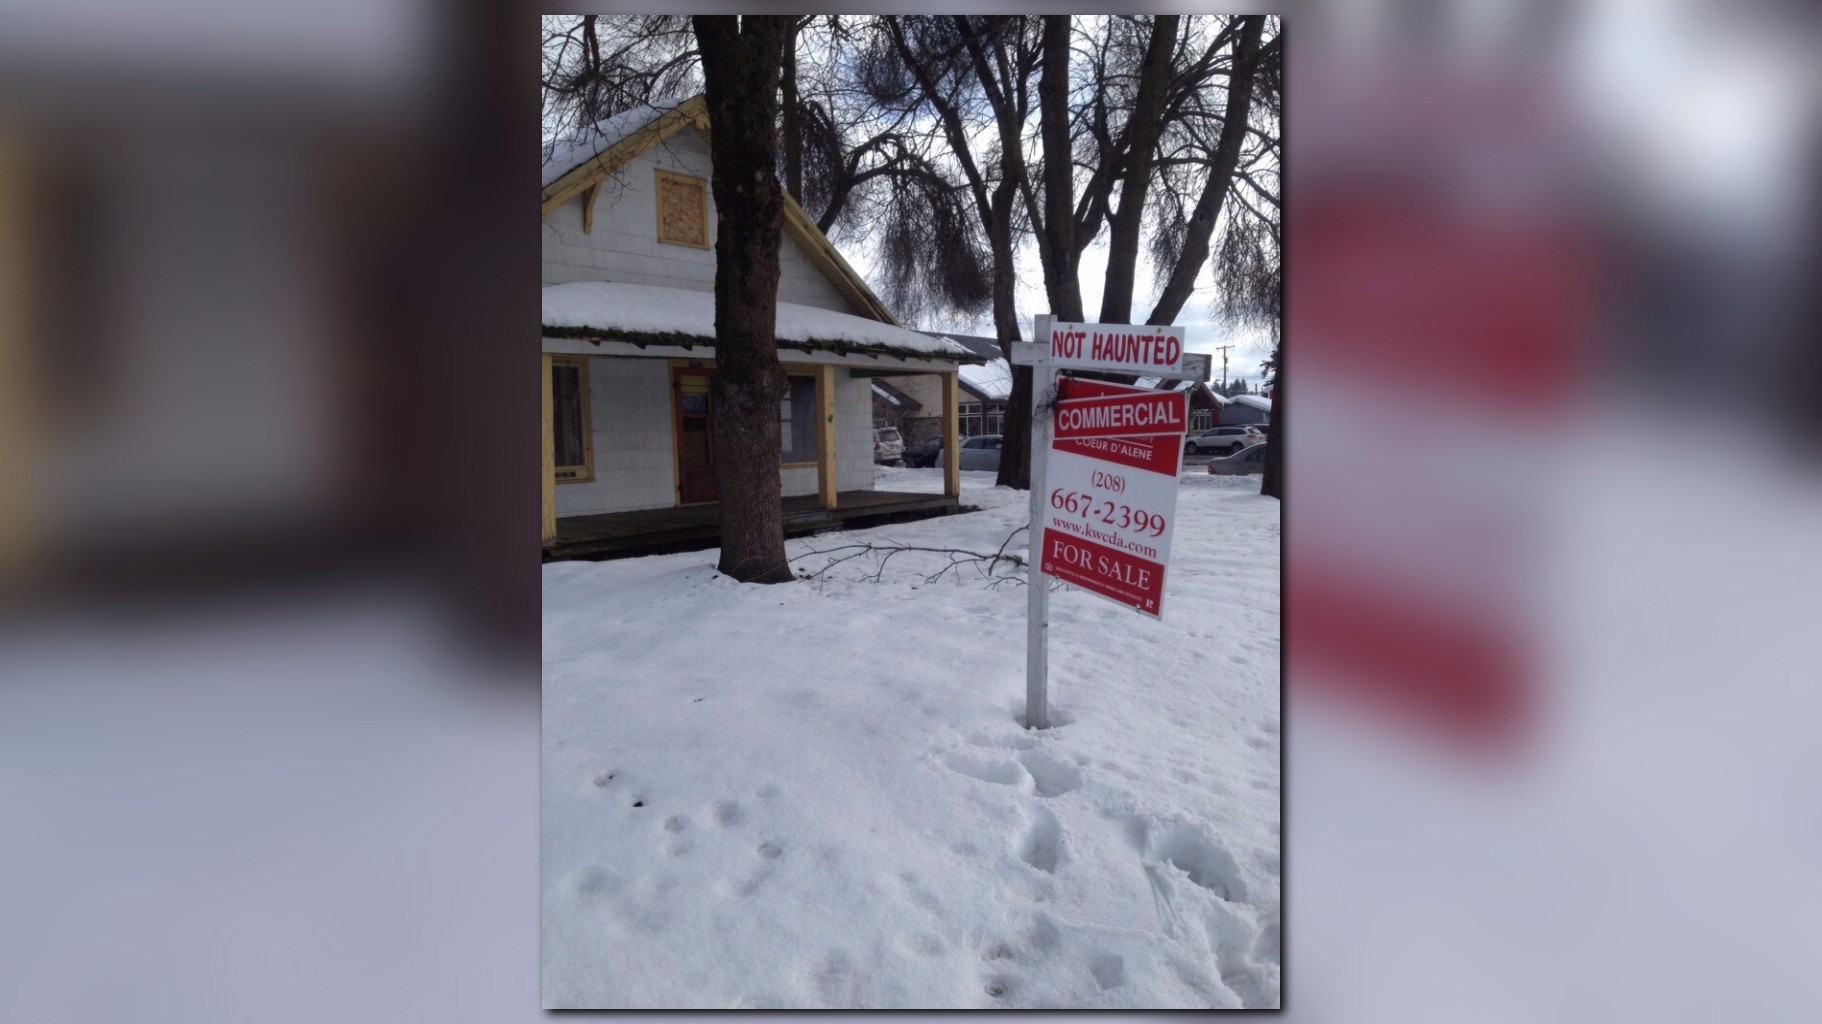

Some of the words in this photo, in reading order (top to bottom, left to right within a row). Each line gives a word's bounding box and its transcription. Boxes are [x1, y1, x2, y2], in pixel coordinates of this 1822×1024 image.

[1052, 330, 1086, 359] NOT
[1092, 332, 1180, 366] HAUNTED
[1058, 401, 1181, 430] COMMERCIAL
[1075, 437, 1108, 451] COEUR
[1110, 444, 1153, 461] D'ALENE
[1091, 469, 1126, 495] (208)
[1051, 488, 1166, 538] 667-2399
[1053, 517, 1157, 559] www.kwcda.com
[1053, 540, 1093, 570] FOR
[1098, 555, 1151, 591] SALE
